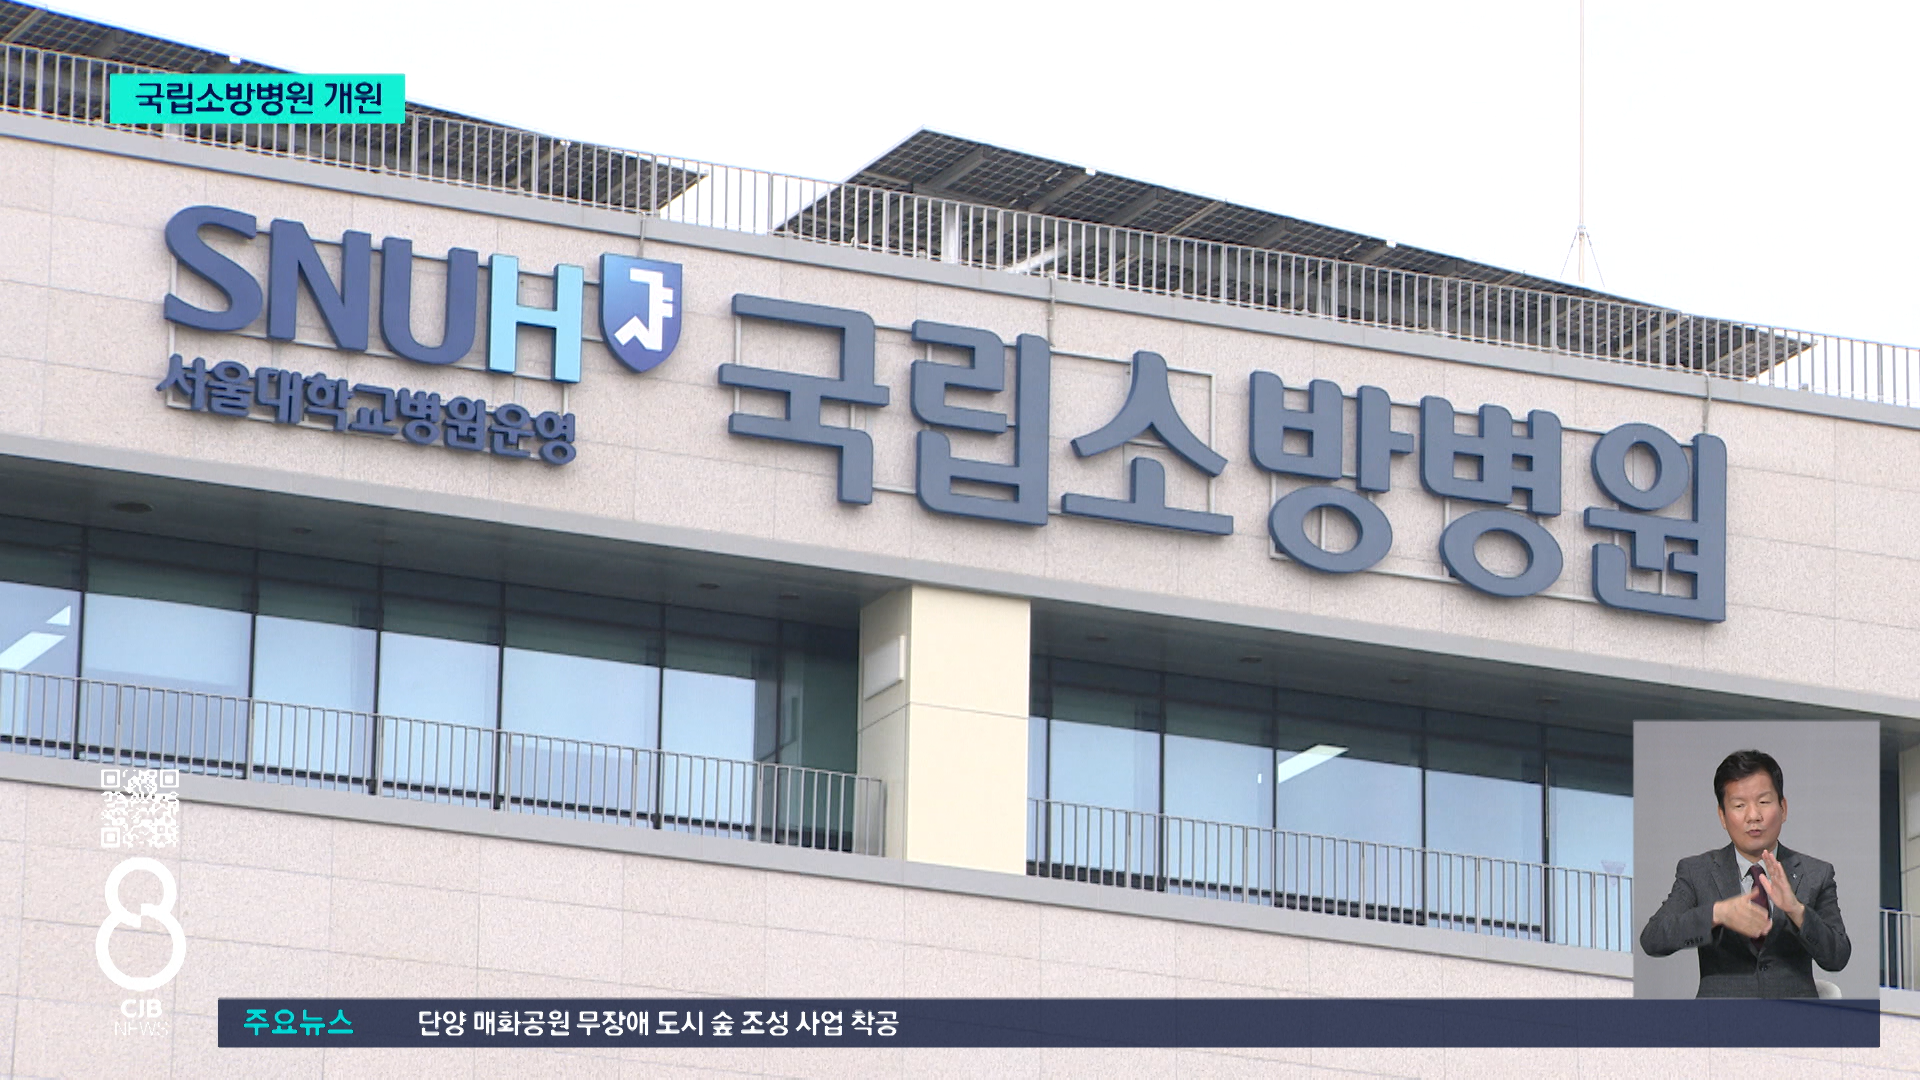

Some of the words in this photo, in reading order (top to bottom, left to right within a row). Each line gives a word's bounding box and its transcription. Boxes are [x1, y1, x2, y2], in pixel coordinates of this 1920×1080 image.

[164, 205, 584, 384] SNUH
[156, 353, 577, 466] 서울대학교병원운영
[718, 293, 1727, 623] 국립소방병원
